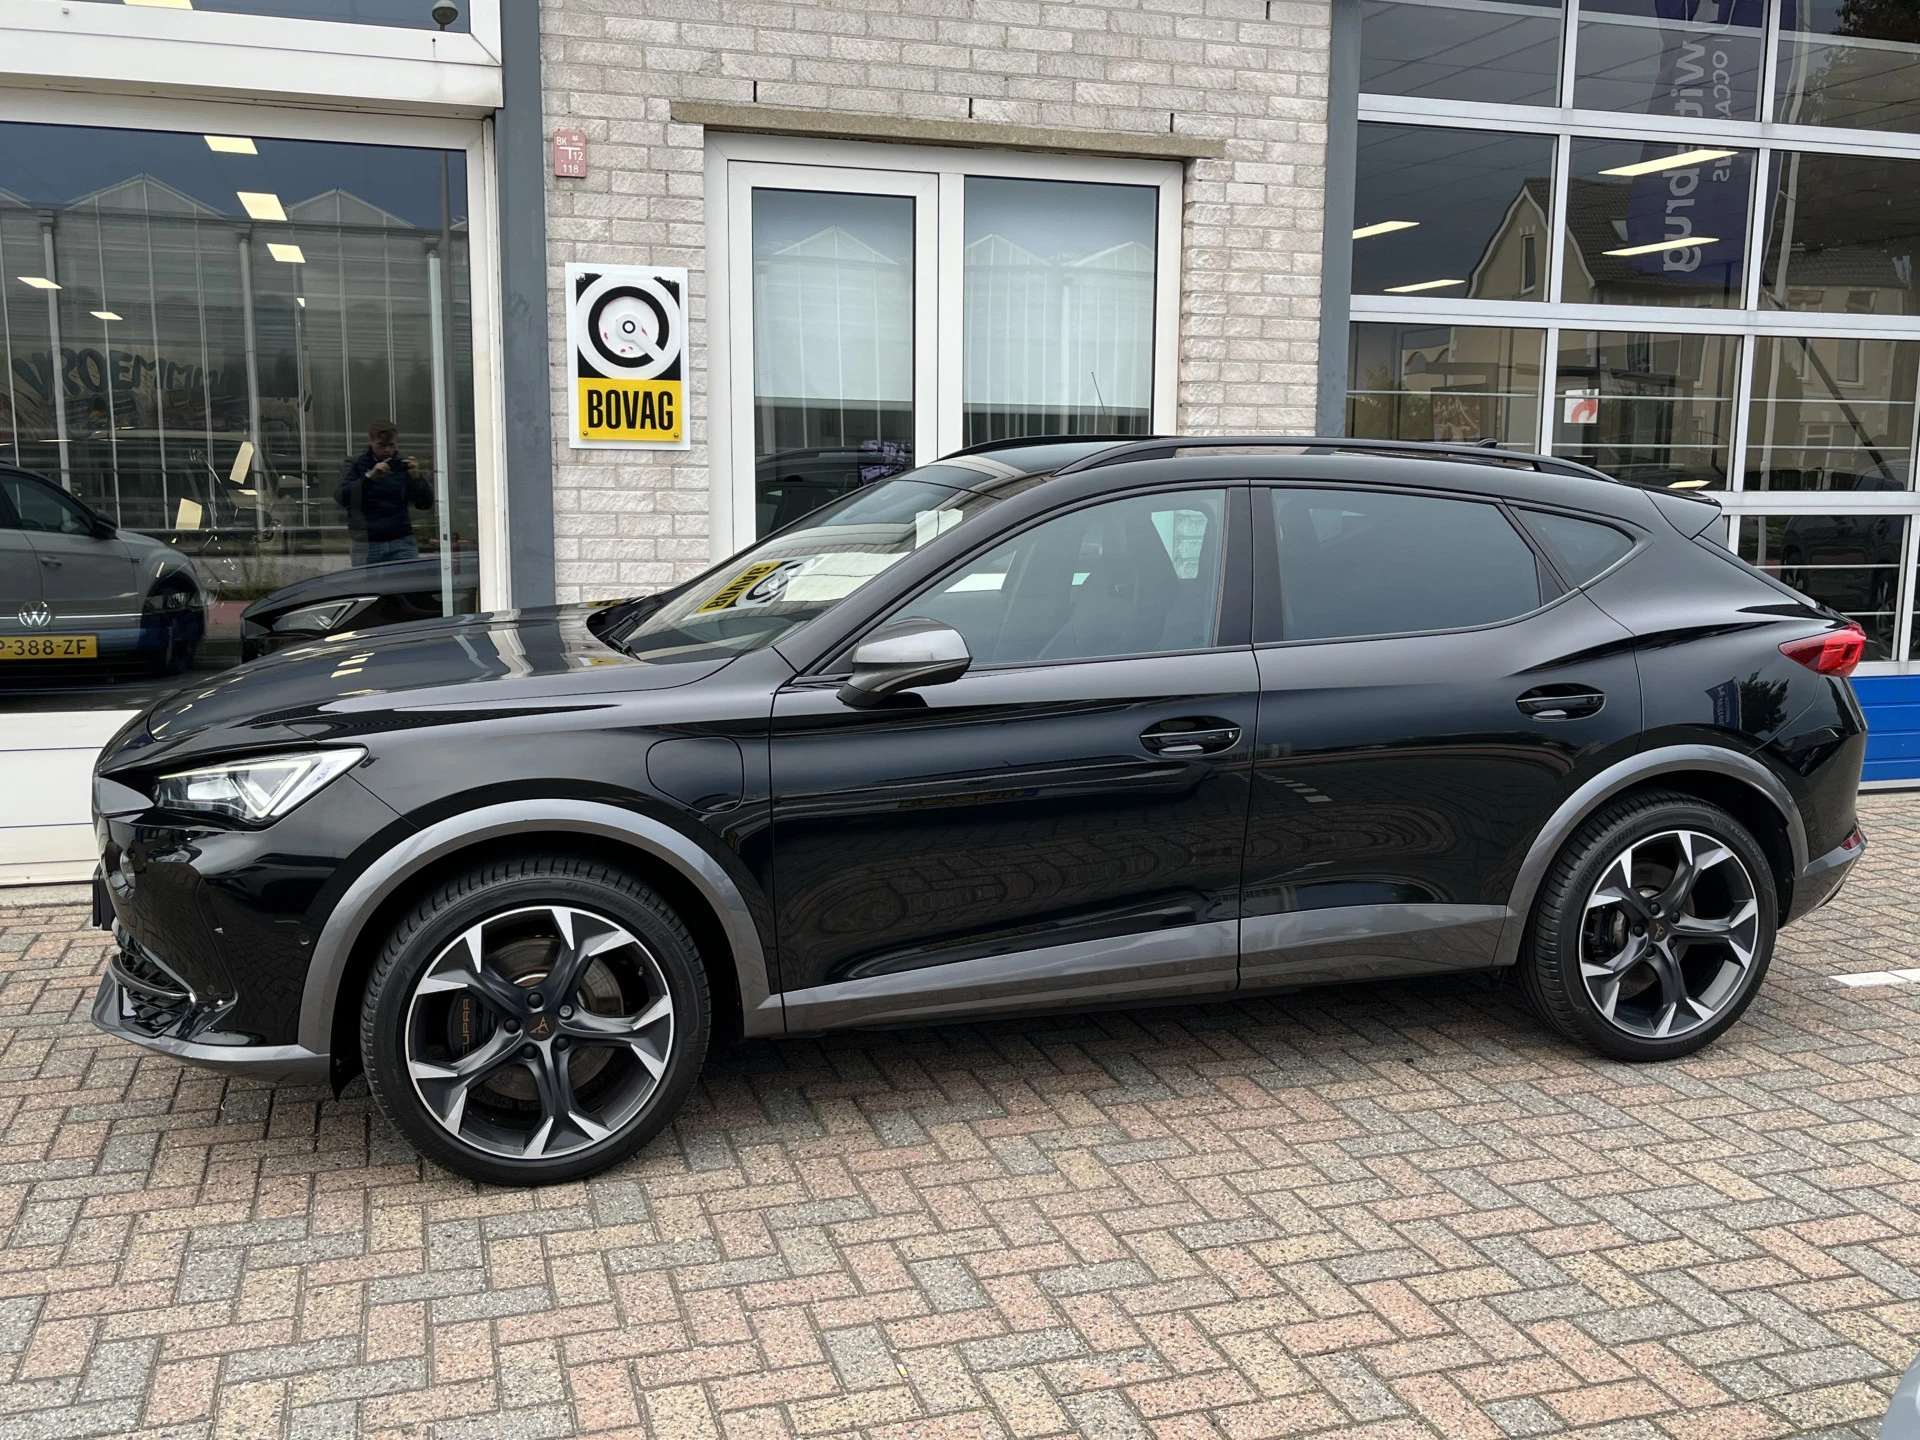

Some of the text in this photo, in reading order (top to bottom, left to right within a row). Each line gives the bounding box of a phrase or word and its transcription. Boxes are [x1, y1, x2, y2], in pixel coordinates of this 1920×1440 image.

[556, 136, 568, 146] BK
[572, 151, 584, 161] 12
[562, 163, 579, 174] 118
[587, 389, 674, 431] BOVAG
